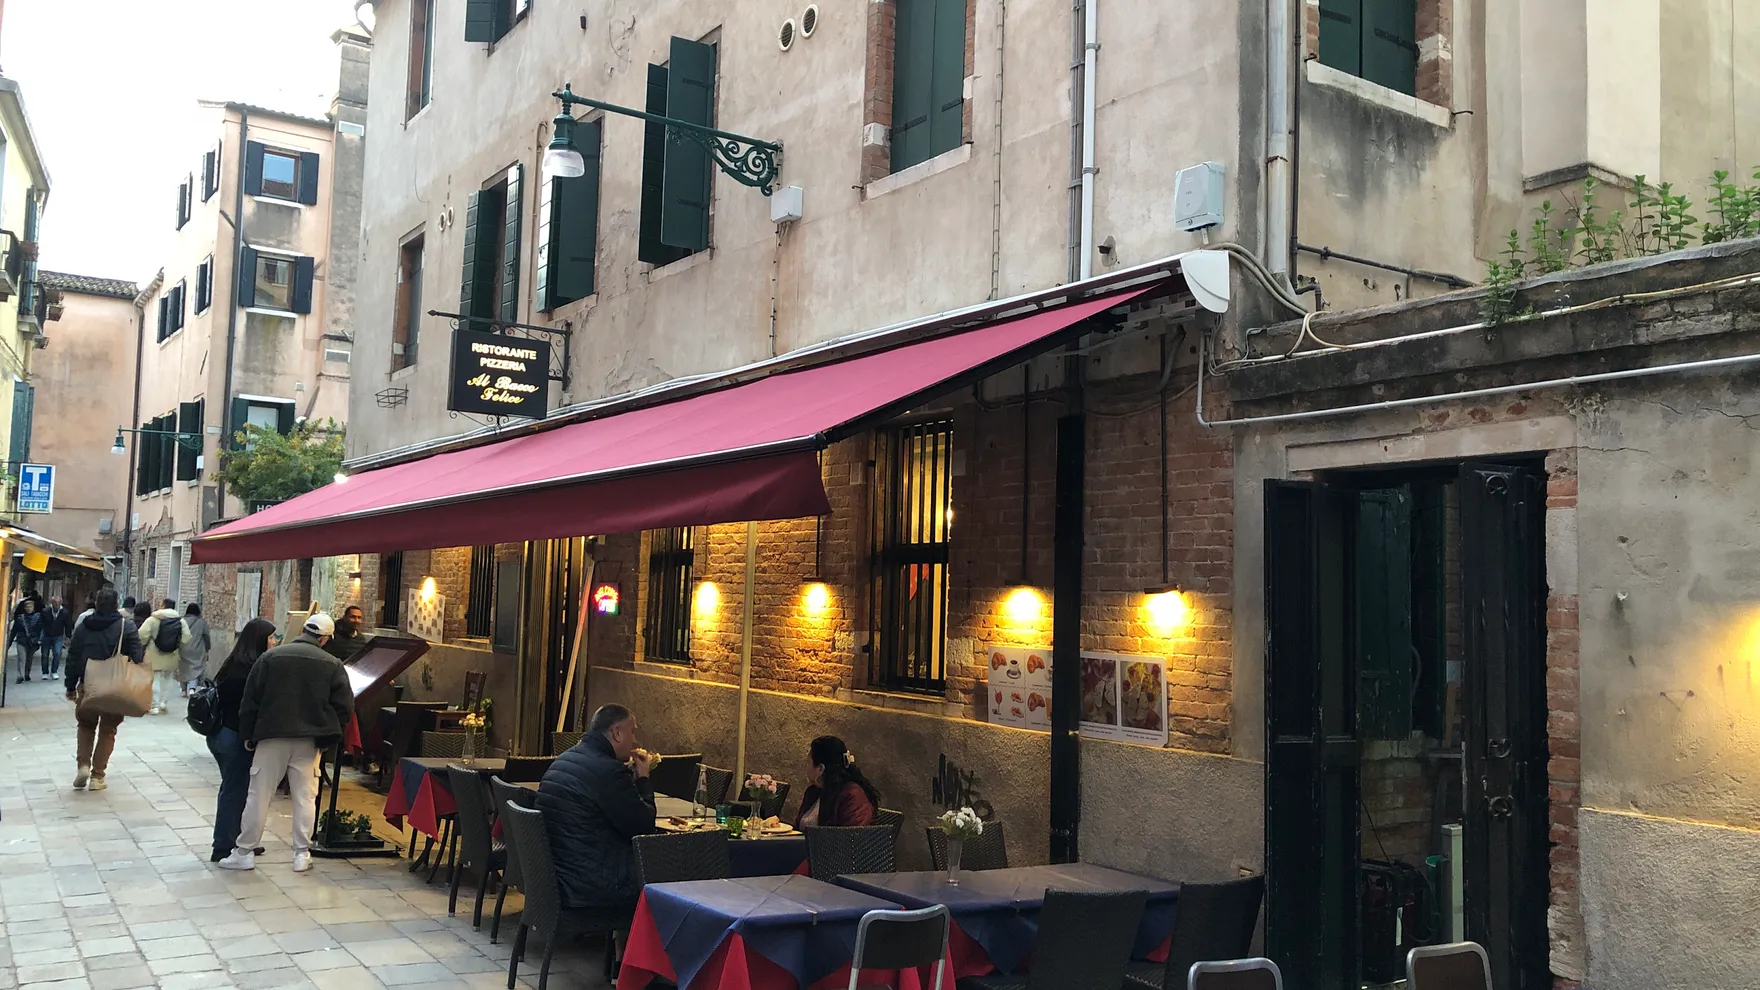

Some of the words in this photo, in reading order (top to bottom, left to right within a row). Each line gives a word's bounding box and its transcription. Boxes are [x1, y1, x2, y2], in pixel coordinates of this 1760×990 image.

[472, 343, 537, 360] RISTORANTE
[480, 357, 526, 372] PIZZERIA
[467, 373, 490, 387] Al
[495, 376, 539, 393] Bacco
[480, 387, 524, 404] Felice
[26, 467, 47, 491] T
